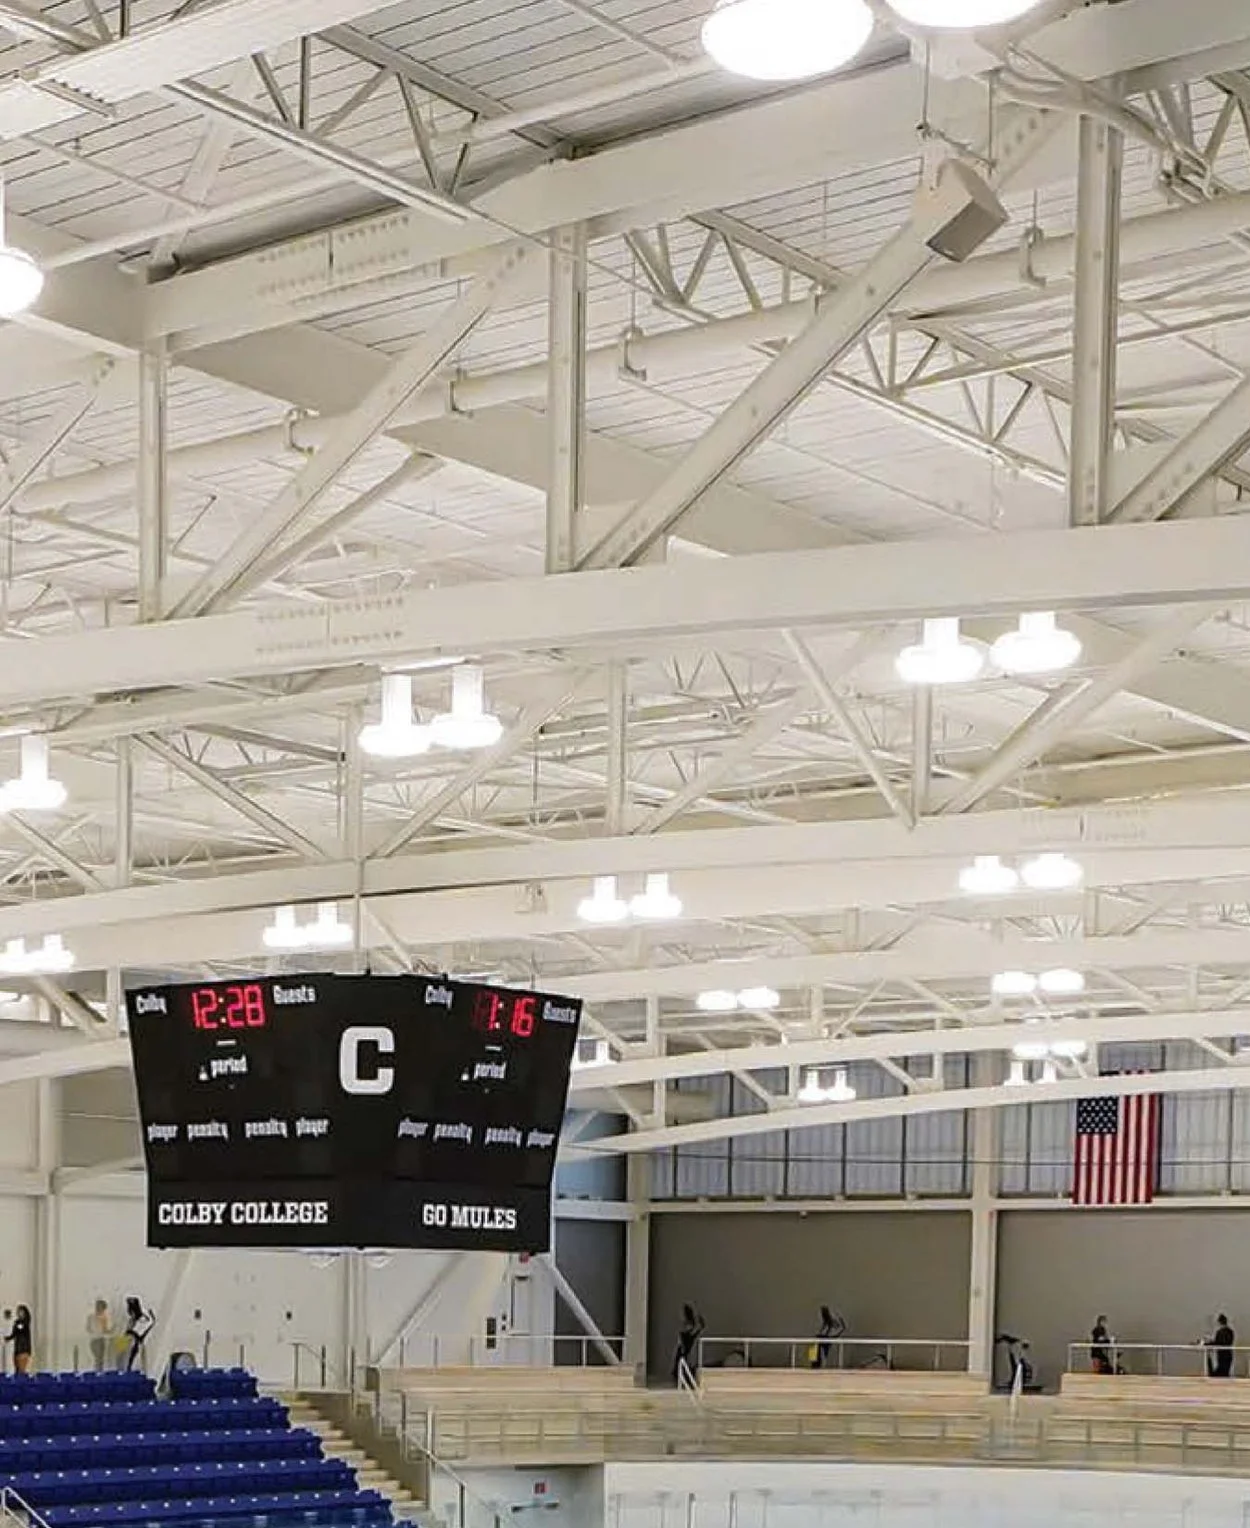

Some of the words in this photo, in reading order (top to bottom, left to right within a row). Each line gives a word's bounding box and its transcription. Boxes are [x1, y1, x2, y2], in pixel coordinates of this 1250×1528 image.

[191, 984, 266, 1029] 12:28
[339, 1026, 395, 1095] C
[158, 1202, 227, 1225] COLBY
[230, 1201, 329, 1225] COLLEGE
[422, 1204, 447, 1226] GO
[451, 1205, 518, 1230] MULES
